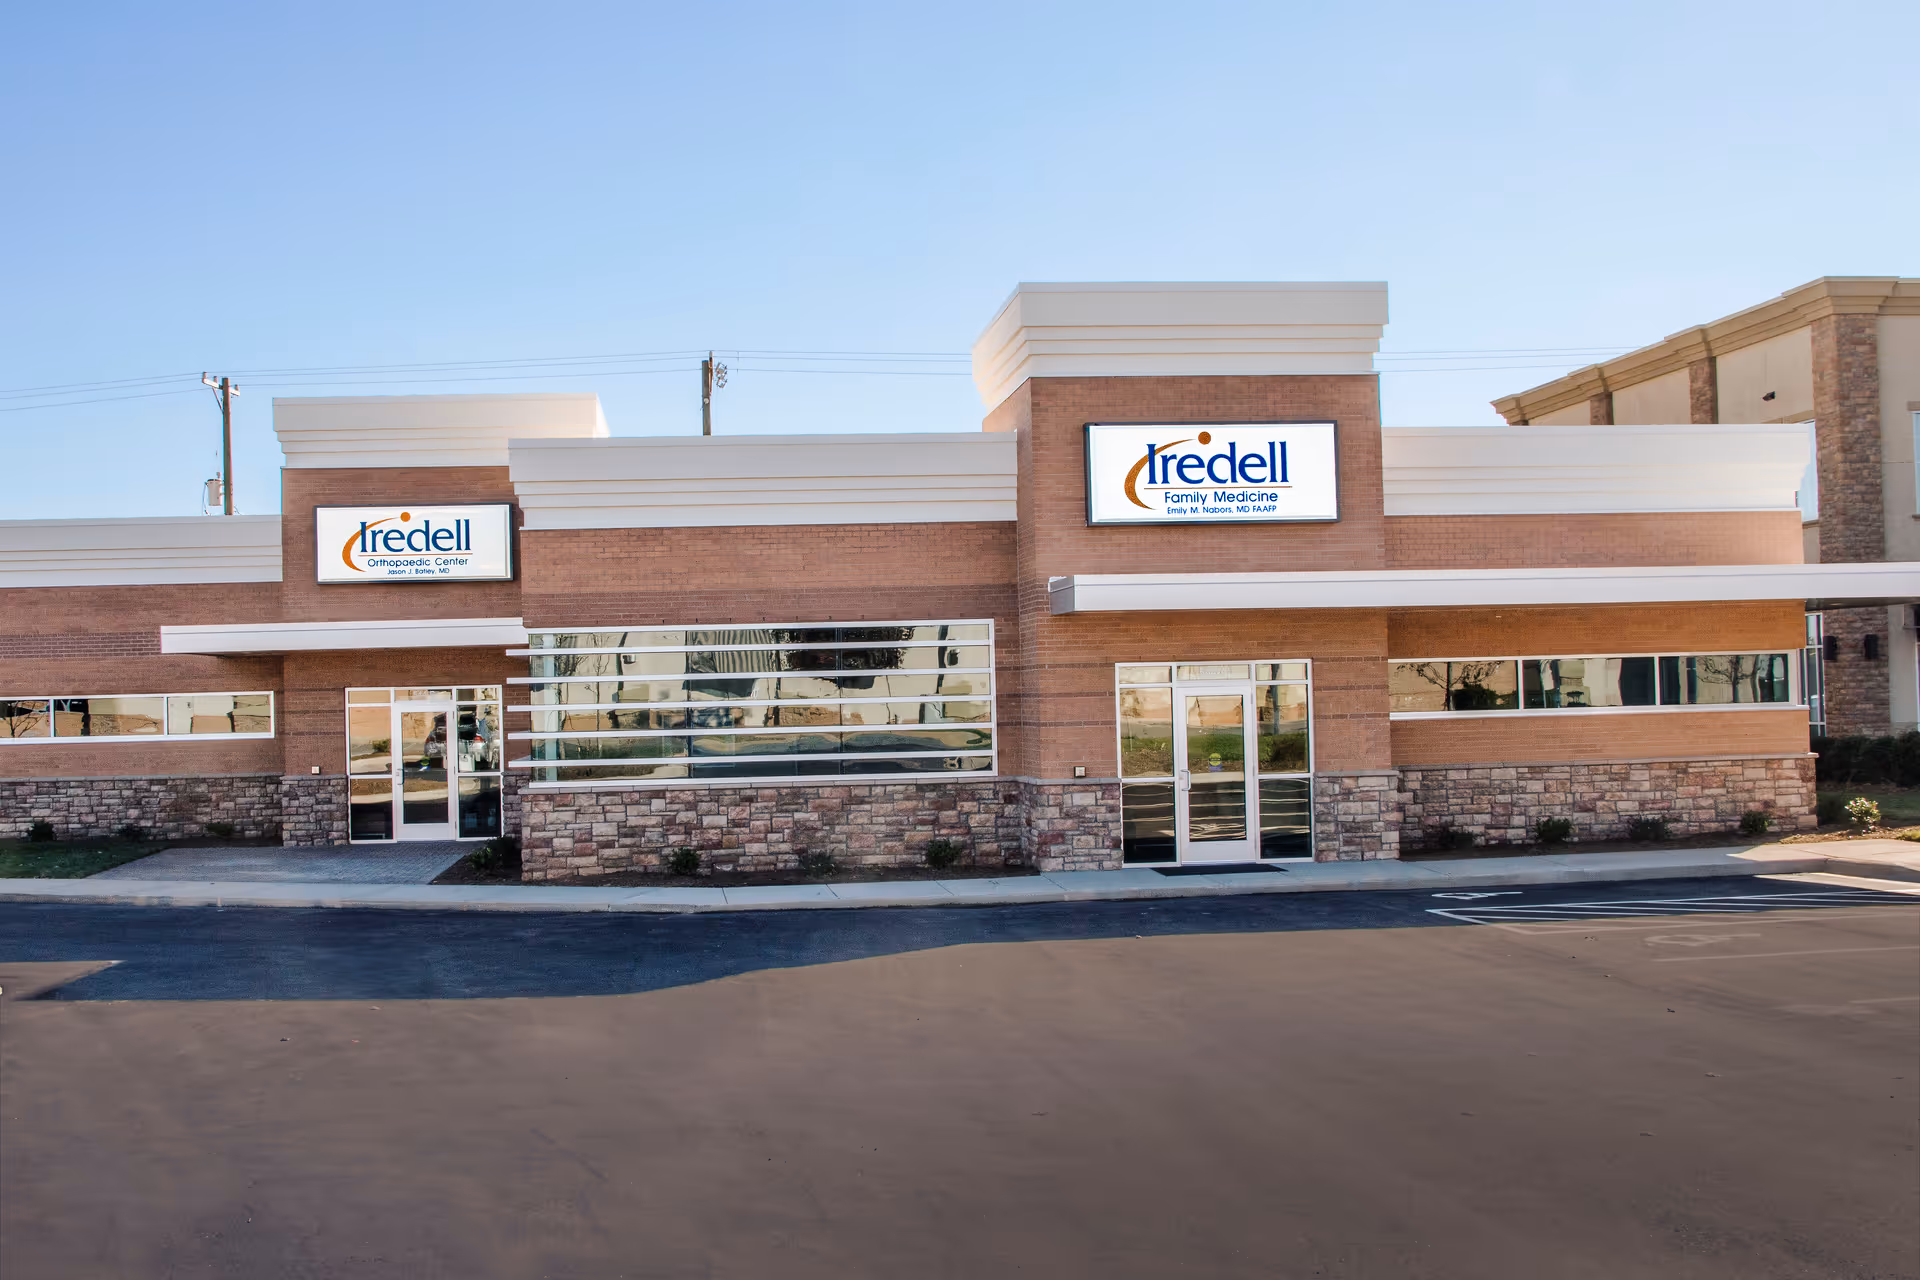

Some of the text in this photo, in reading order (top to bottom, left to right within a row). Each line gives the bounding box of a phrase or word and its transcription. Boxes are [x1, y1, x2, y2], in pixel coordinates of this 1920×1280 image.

[1146, 441, 1290, 484] Iredell
[1164, 490, 1279, 505] Family Medicine
[1167, 506, 1188, 515] Emily
[1236, 505, 1251, 513] MD
[1252, 504, 1277, 513] FAAFP
[359, 519, 472, 552] Iredell
[367, 557, 469, 568] Orthopaedic Center
